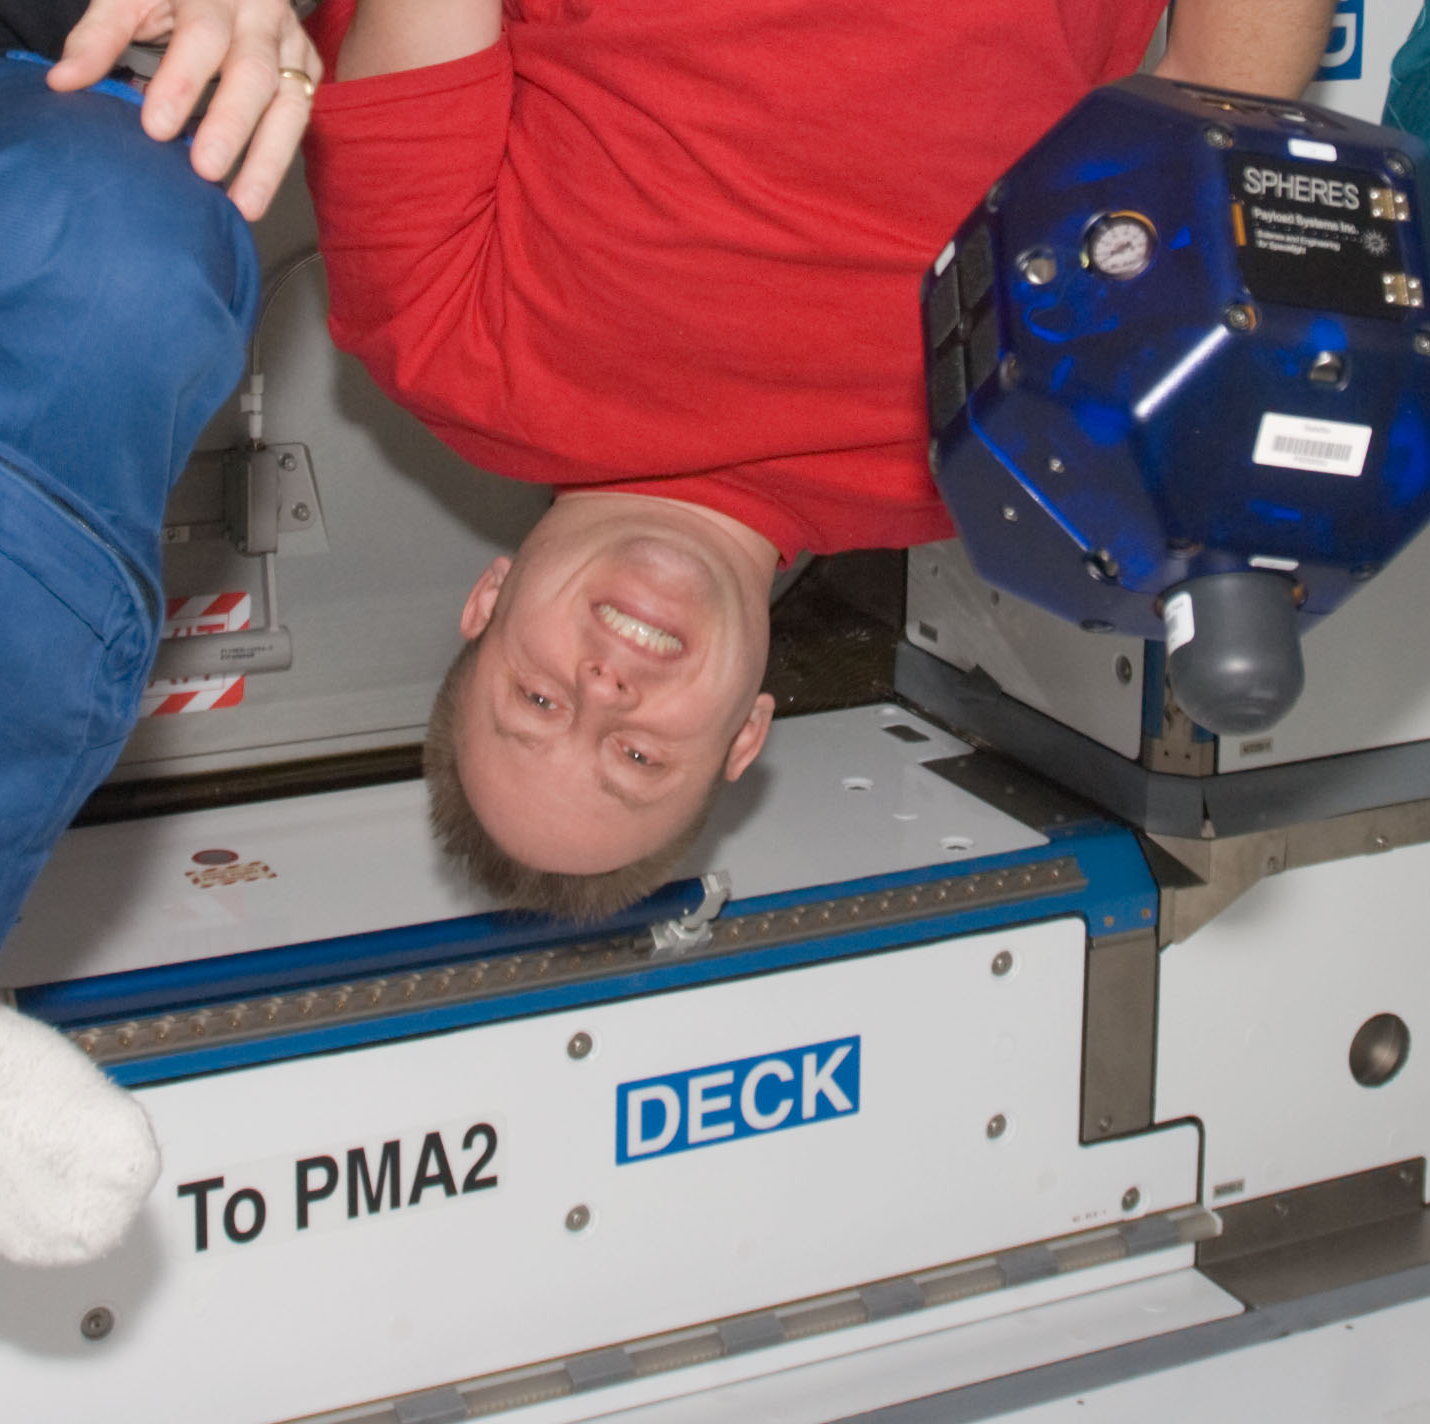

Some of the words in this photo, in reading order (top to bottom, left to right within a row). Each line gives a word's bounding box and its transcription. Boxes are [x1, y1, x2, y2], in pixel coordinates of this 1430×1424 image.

[1242, 165, 1360, 211] SPHERES
[1251, 205, 1295, 225] Payload
[1296, 213, 1340, 231] Systems
[625, 1042, 857, 1159] DECK
[177, 1175, 266, 1251] To
[295, 1122, 500, 1229] PMA2
